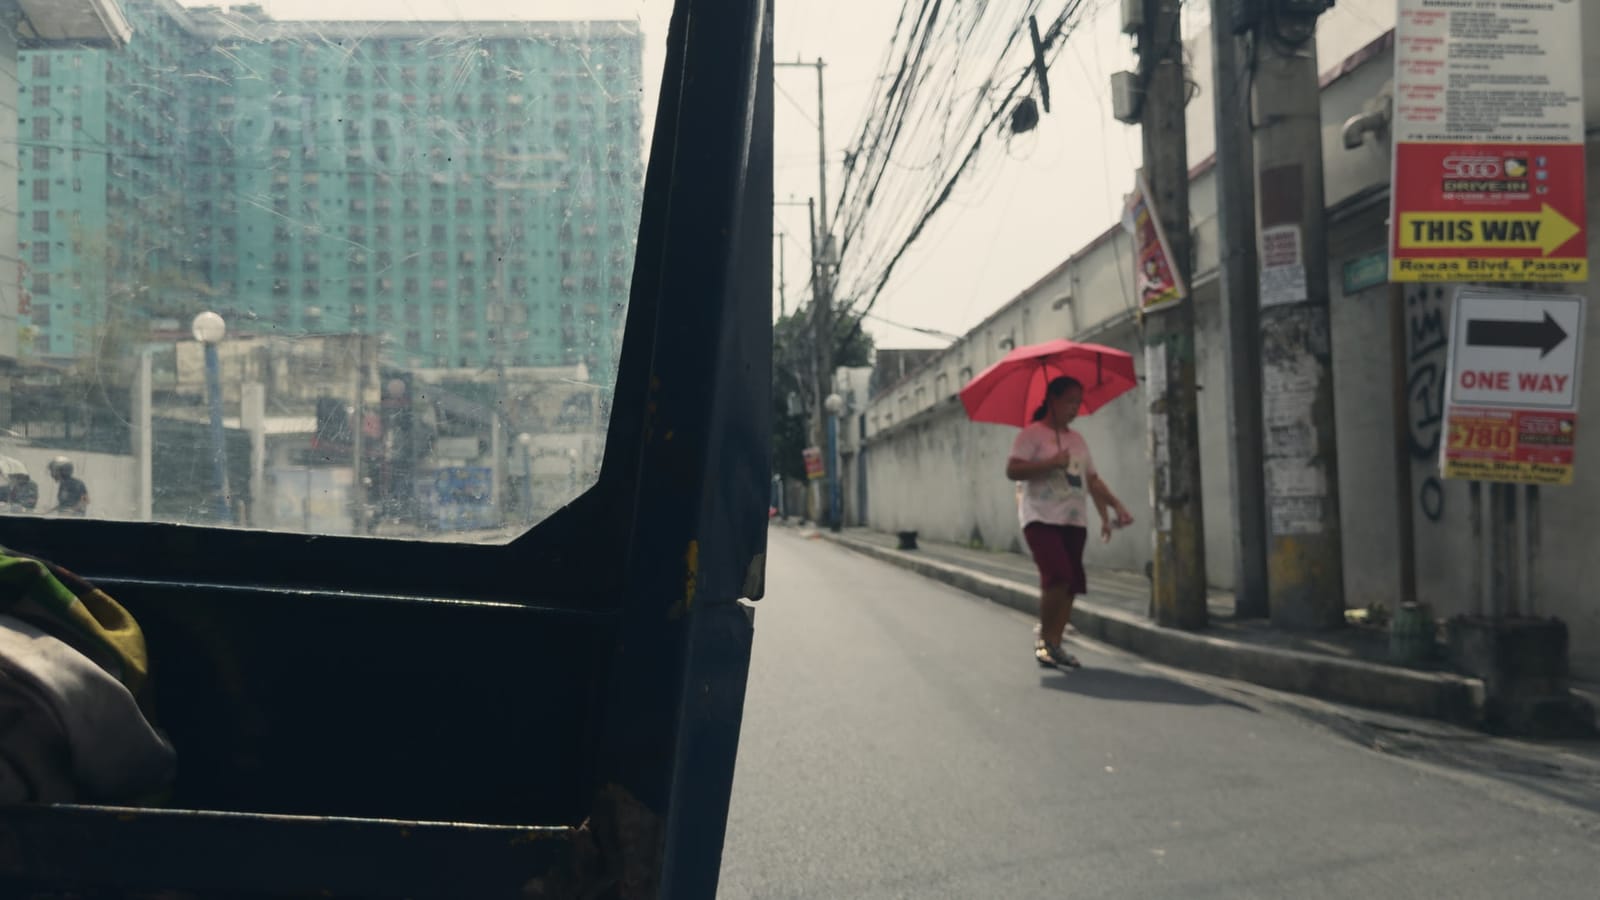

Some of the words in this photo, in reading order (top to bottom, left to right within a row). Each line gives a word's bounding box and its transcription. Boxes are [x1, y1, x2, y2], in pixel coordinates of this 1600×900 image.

[1411, 220, 1474, 242] THIS
[1481, 220, 1541, 242] WAY
[1399, 259, 1460, 271] Roxas
[1522, 260, 1581, 273] Pasay
[1460, 370, 1510, 390] ONE
[1518, 372, 1568, 394] WAY
